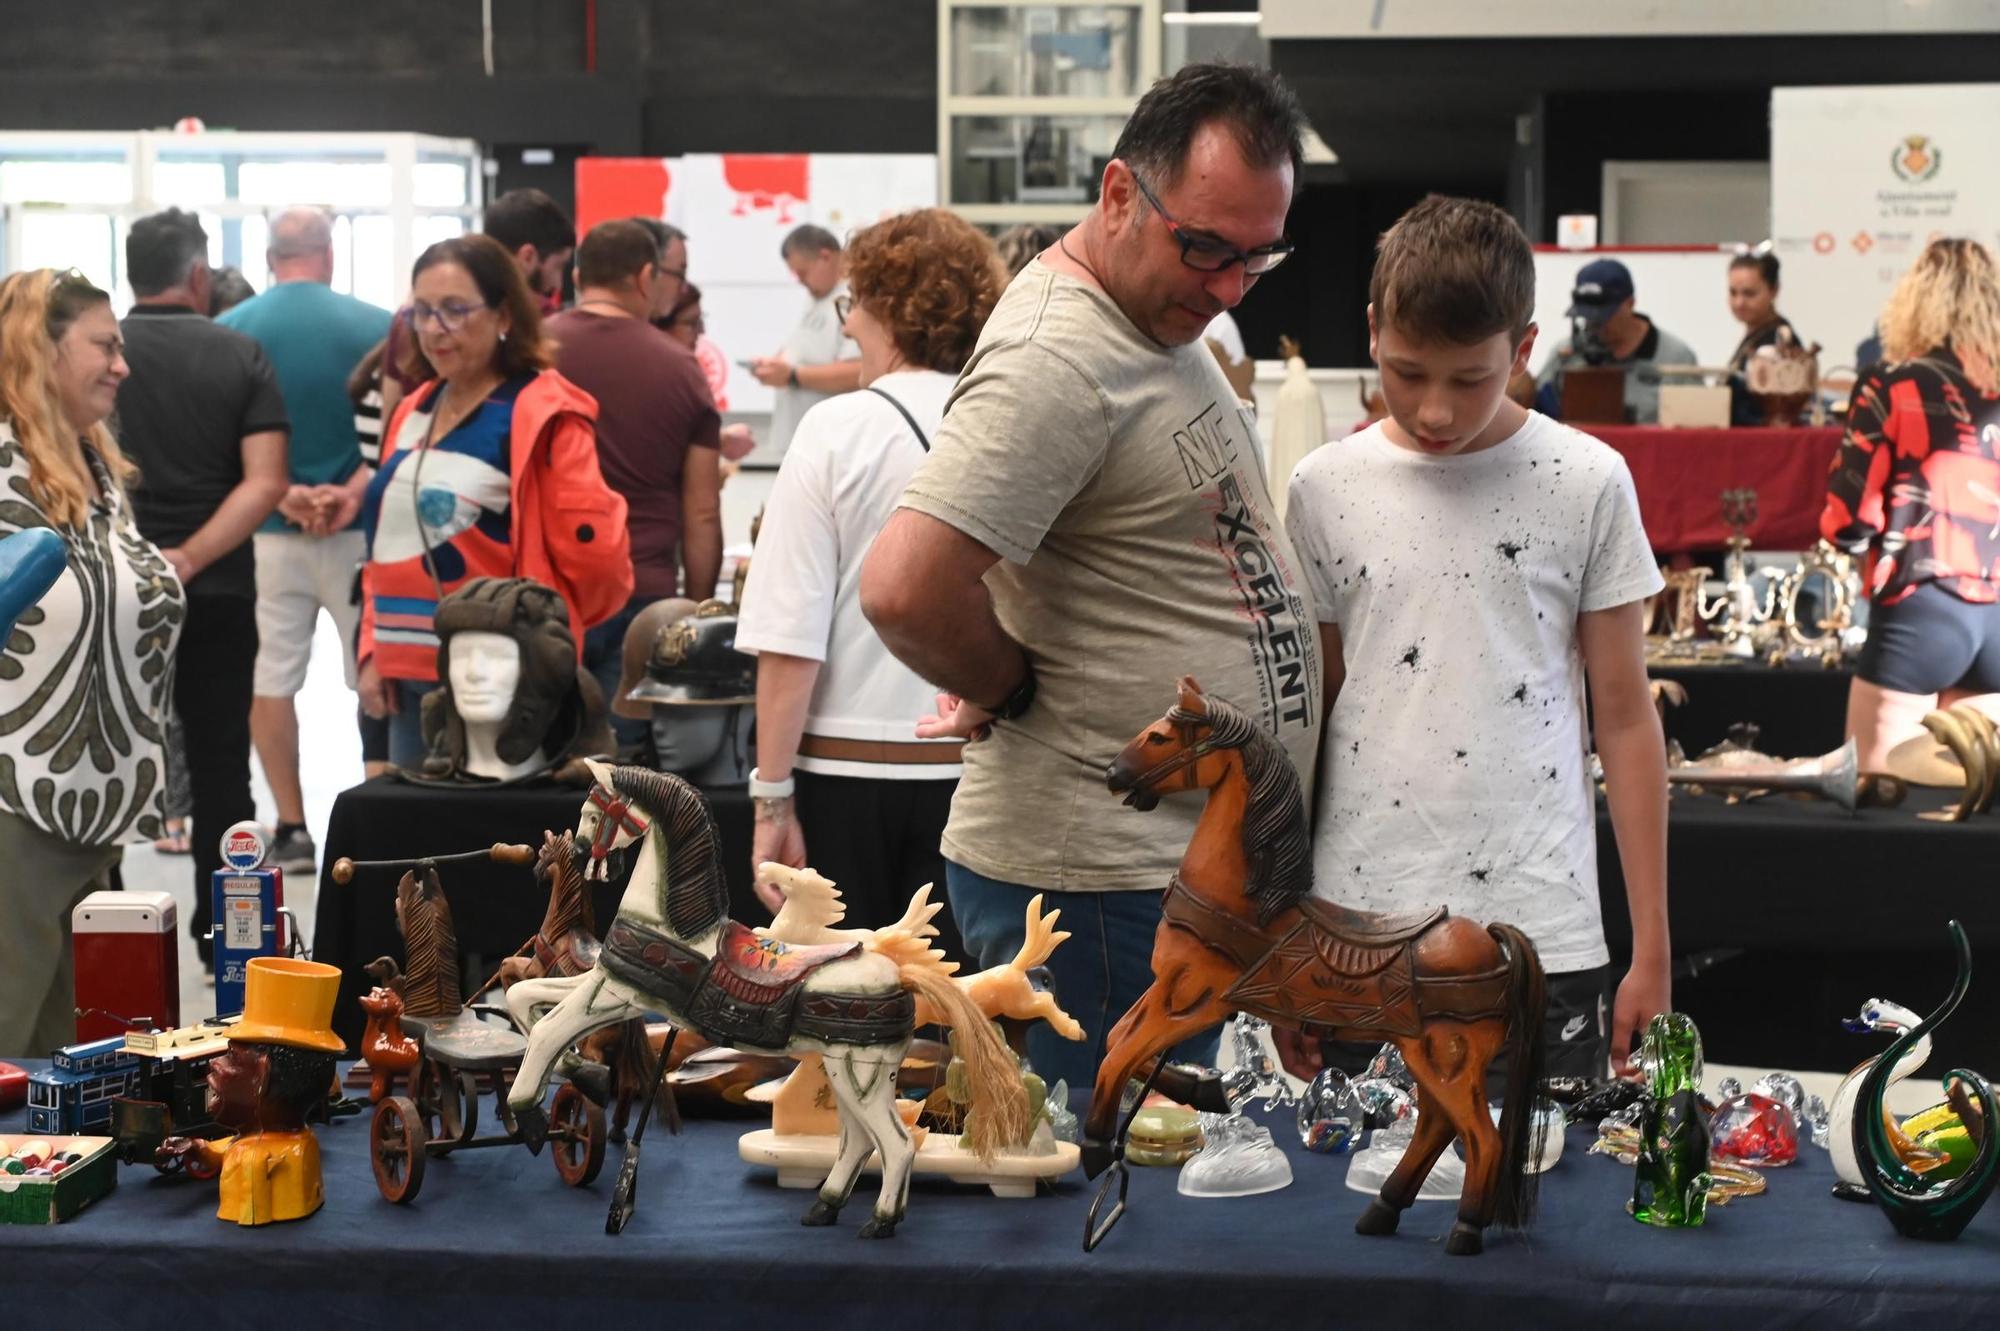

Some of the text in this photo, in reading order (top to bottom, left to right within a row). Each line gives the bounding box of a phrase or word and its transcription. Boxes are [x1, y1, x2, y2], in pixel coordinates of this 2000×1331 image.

[1216, 473, 1309, 729] EXCELENT
[1256, 668, 1268, 699] STYLE
[223, 882, 260, 890] REGULAR
